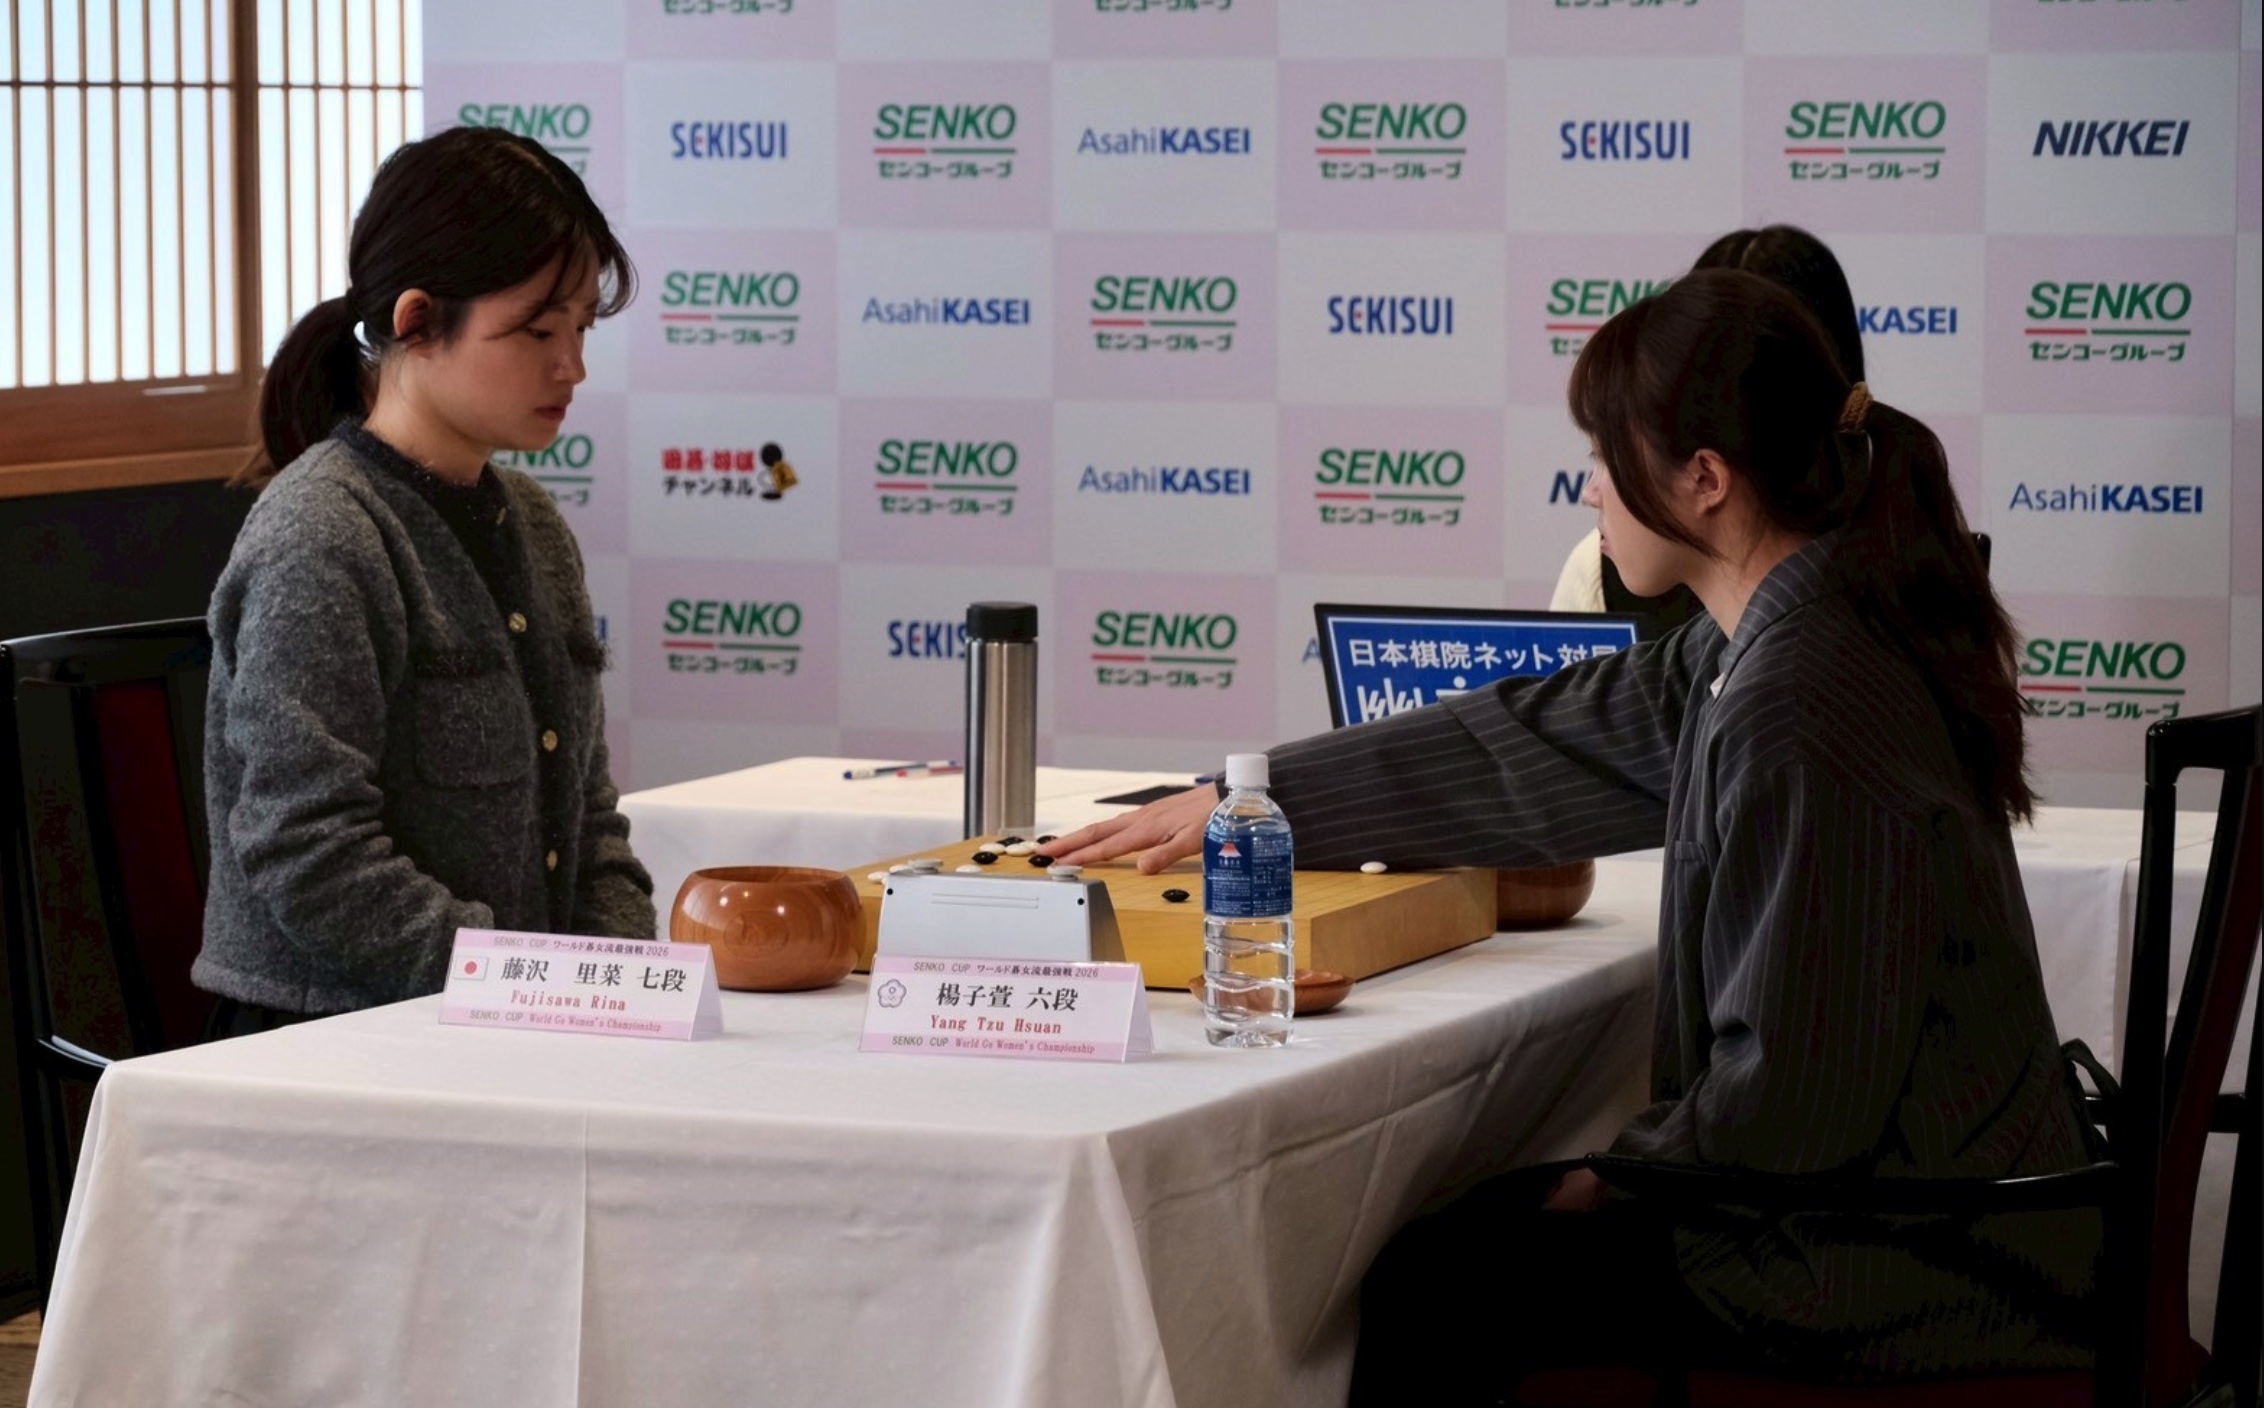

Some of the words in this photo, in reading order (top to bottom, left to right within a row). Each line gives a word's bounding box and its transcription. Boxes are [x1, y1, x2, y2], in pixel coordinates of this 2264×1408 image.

[459, 103, 591, 139] SENKO
[873, 104, 1018, 141] SENKO
[1315, 103, 1468, 141] SENKO
[1785, 101, 1947, 140] SENKO
[671, 121, 788, 159] SEKISUI
[1560, 120, 1690, 161] SEKISUI
[2032, 120, 2191, 158] NIKKEI
[878, 160, 1013, 179] センコーグループ
[1320, 160, 1462, 180] センコーグループ
[1789, 160, 1941, 180] センコーグループ
[661, 272, 800, 309] SENKO
[1091, 276, 1238, 314] SENKO
[2025, 282, 2192, 322] SENKO
[1327, 296, 1454, 336] SEKISUI
[666, 327, 797, 346] センコーグループ
[1095, 331, 1233, 352] センコーグループ
[2030, 343, 2186, 363] センコーグループ
[876, 440, 1018, 479] SENKO
[1315, 448, 1466, 488] SENKO
[663, 476, 755, 497] チャンネル
[880, 496, 1014, 515] センコーグループ
[1319, 505, 1461, 526] センコーグループ
[663, 599, 803, 638] SENKO
[1092, 611, 1238, 651] SENKO
[667, 654, 798, 676] センコーグループ
[2021, 638, 2187, 681] SENKO
[1096, 667, 1233, 689] センコーグループ
[494, 937, 524, 948] SENKO
[529, 938, 548, 949] CUP
[646, 945, 670, 957] 2026
[501, 957, 550, 982] 藤沢
[573, 962, 625, 988] 里菜
[636, 966, 687, 992] 七段
[913, 961, 945, 972] SENKO
[951, 963, 971, 973] CUP
[1075, 967, 1099, 978] 2026
[510, 990, 581, 1008] Fujisawa
[591, 995, 626, 1012] Rina
[936, 982, 1014, 1008] 楊子萱
[1026, 986, 1079, 1011] 六段
[470, 1010, 500, 1021] SENKO
[505, 1012, 524, 1022] CUP
[530, 1013, 551, 1024] World
[554, 1015, 565, 1026] Go
[607, 1019, 662, 1032] Championship
[930, 1014, 967, 1031] Yang
[977, 1016, 1005, 1031] Tzu
[1014, 1018, 1062, 1034] Hsuan
[892, 1035, 923, 1046] SENKO
[929, 1037, 949, 1047] CUP
[955, 1038, 979, 1048] World
[982, 1039, 993, 1049] Go
[1037, 1041, 1095, 1054] Championship
